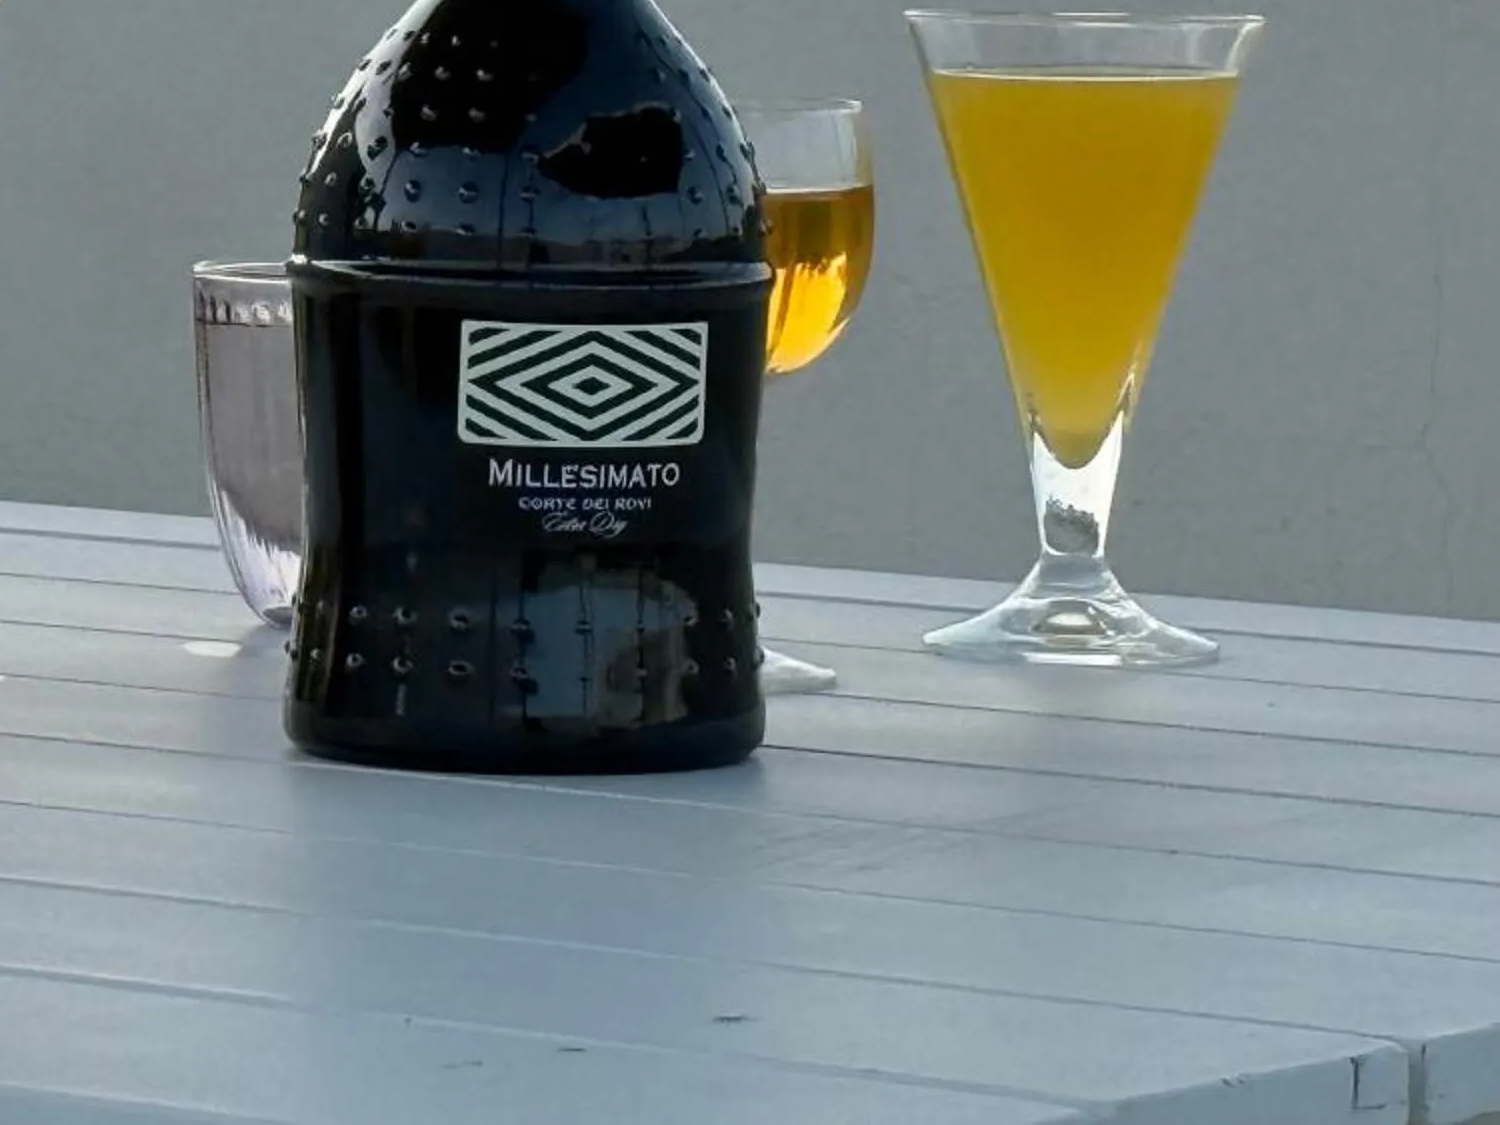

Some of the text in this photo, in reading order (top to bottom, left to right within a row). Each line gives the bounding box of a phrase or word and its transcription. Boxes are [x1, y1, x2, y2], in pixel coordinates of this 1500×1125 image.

[487, 457, 680, 489] MILLESIMATO
[517, 496, 652, 512] CORTE DEI ROVI
